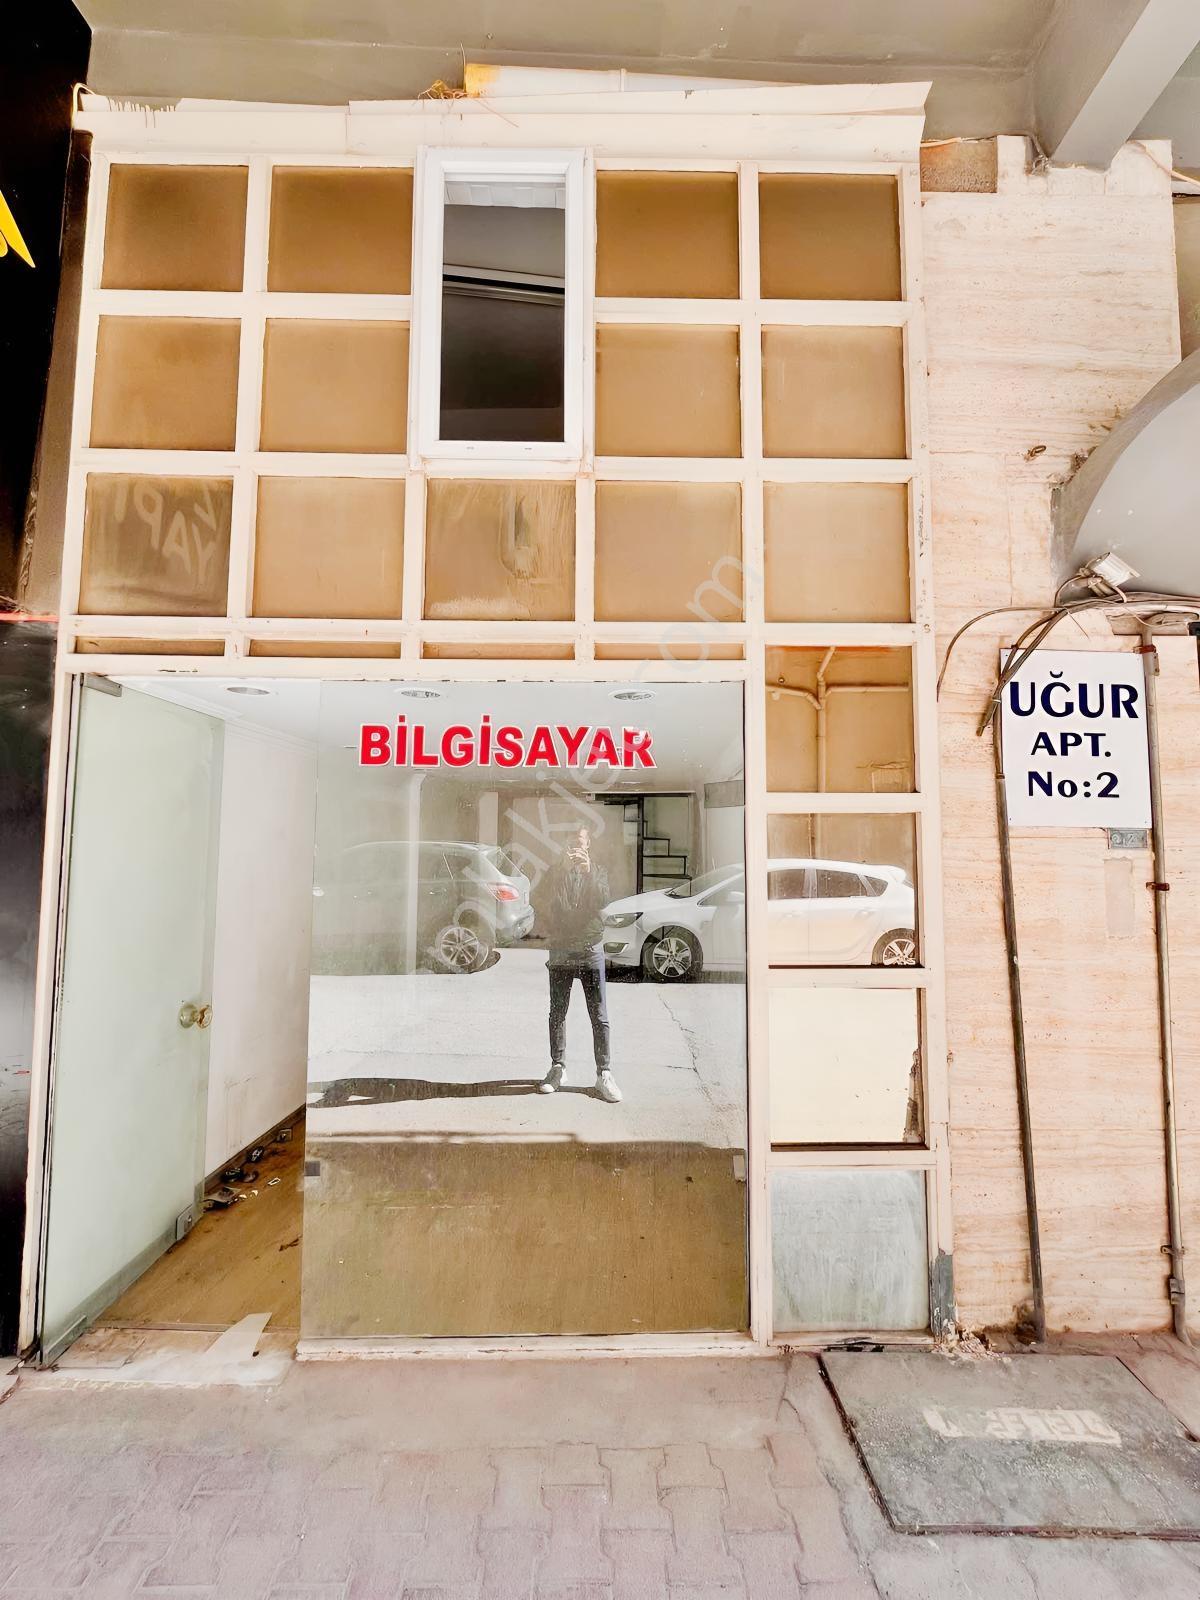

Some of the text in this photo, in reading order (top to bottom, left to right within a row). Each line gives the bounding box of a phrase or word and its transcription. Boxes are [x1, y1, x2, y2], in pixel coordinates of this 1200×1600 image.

[1009, 671, 1139, 718] UĞUR
[359, 714, 657, 768] BİLGİSAYAR
[1030, 731, 1112, 757] APT.
[1027, 771, 1120, 798] No:2
